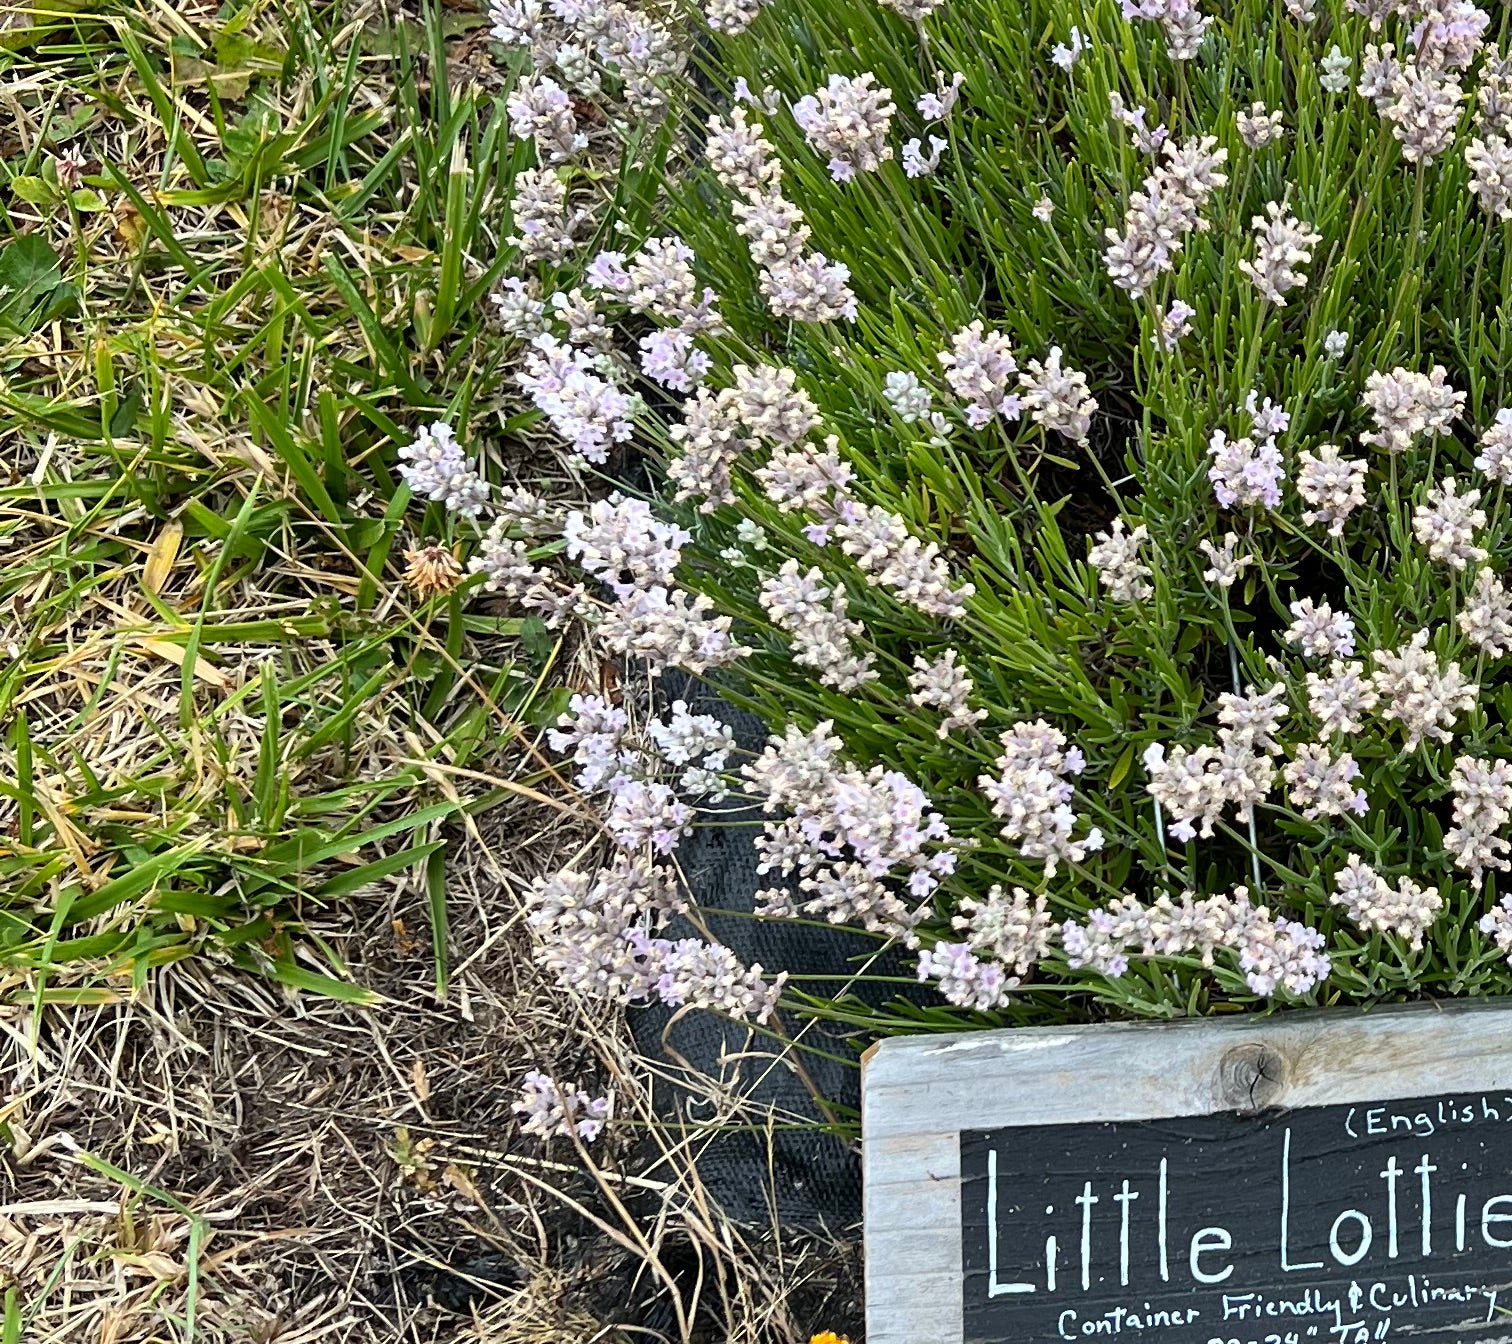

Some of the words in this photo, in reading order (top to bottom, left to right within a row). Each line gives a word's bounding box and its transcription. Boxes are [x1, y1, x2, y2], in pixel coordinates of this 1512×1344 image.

[987, 1149, 1234, 1298] Little
[1058, 1302, 1200, 1340] Container
[1223, 1288, 1343, 1326] Friendly
[1370, 1275, 1497, 1322] Culinary
